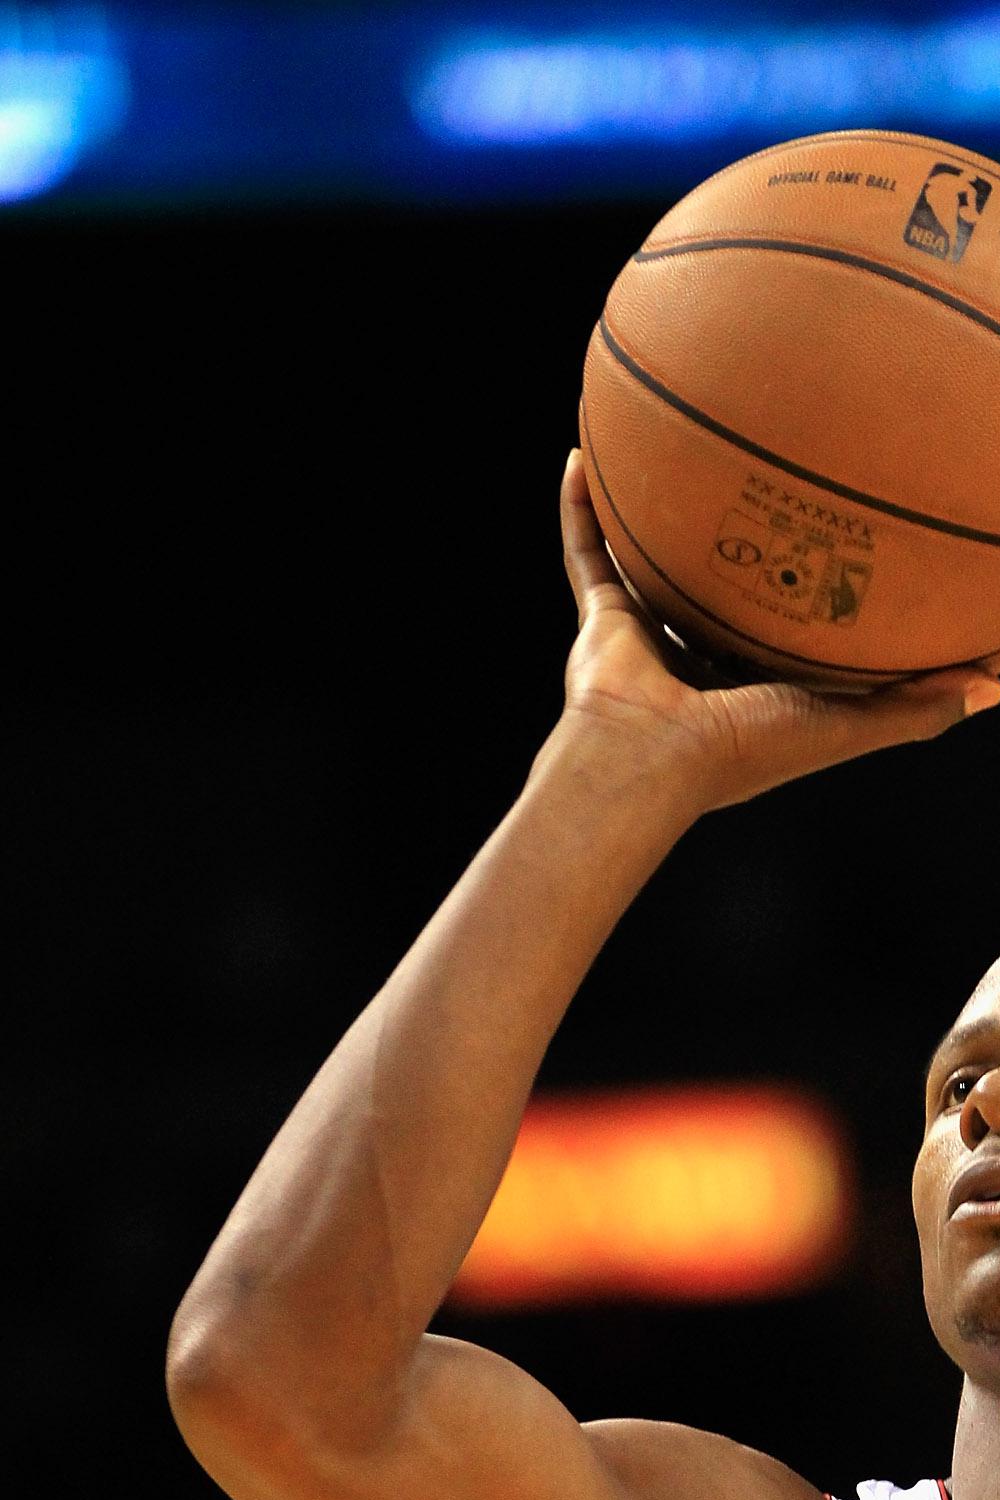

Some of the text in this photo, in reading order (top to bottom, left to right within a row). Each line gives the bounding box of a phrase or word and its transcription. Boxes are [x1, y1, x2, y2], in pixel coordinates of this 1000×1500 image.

[825, 170, 862, 185] GAME
[865, 174, 896, 192] BALL
[909, 224, 946, 254] NBA
